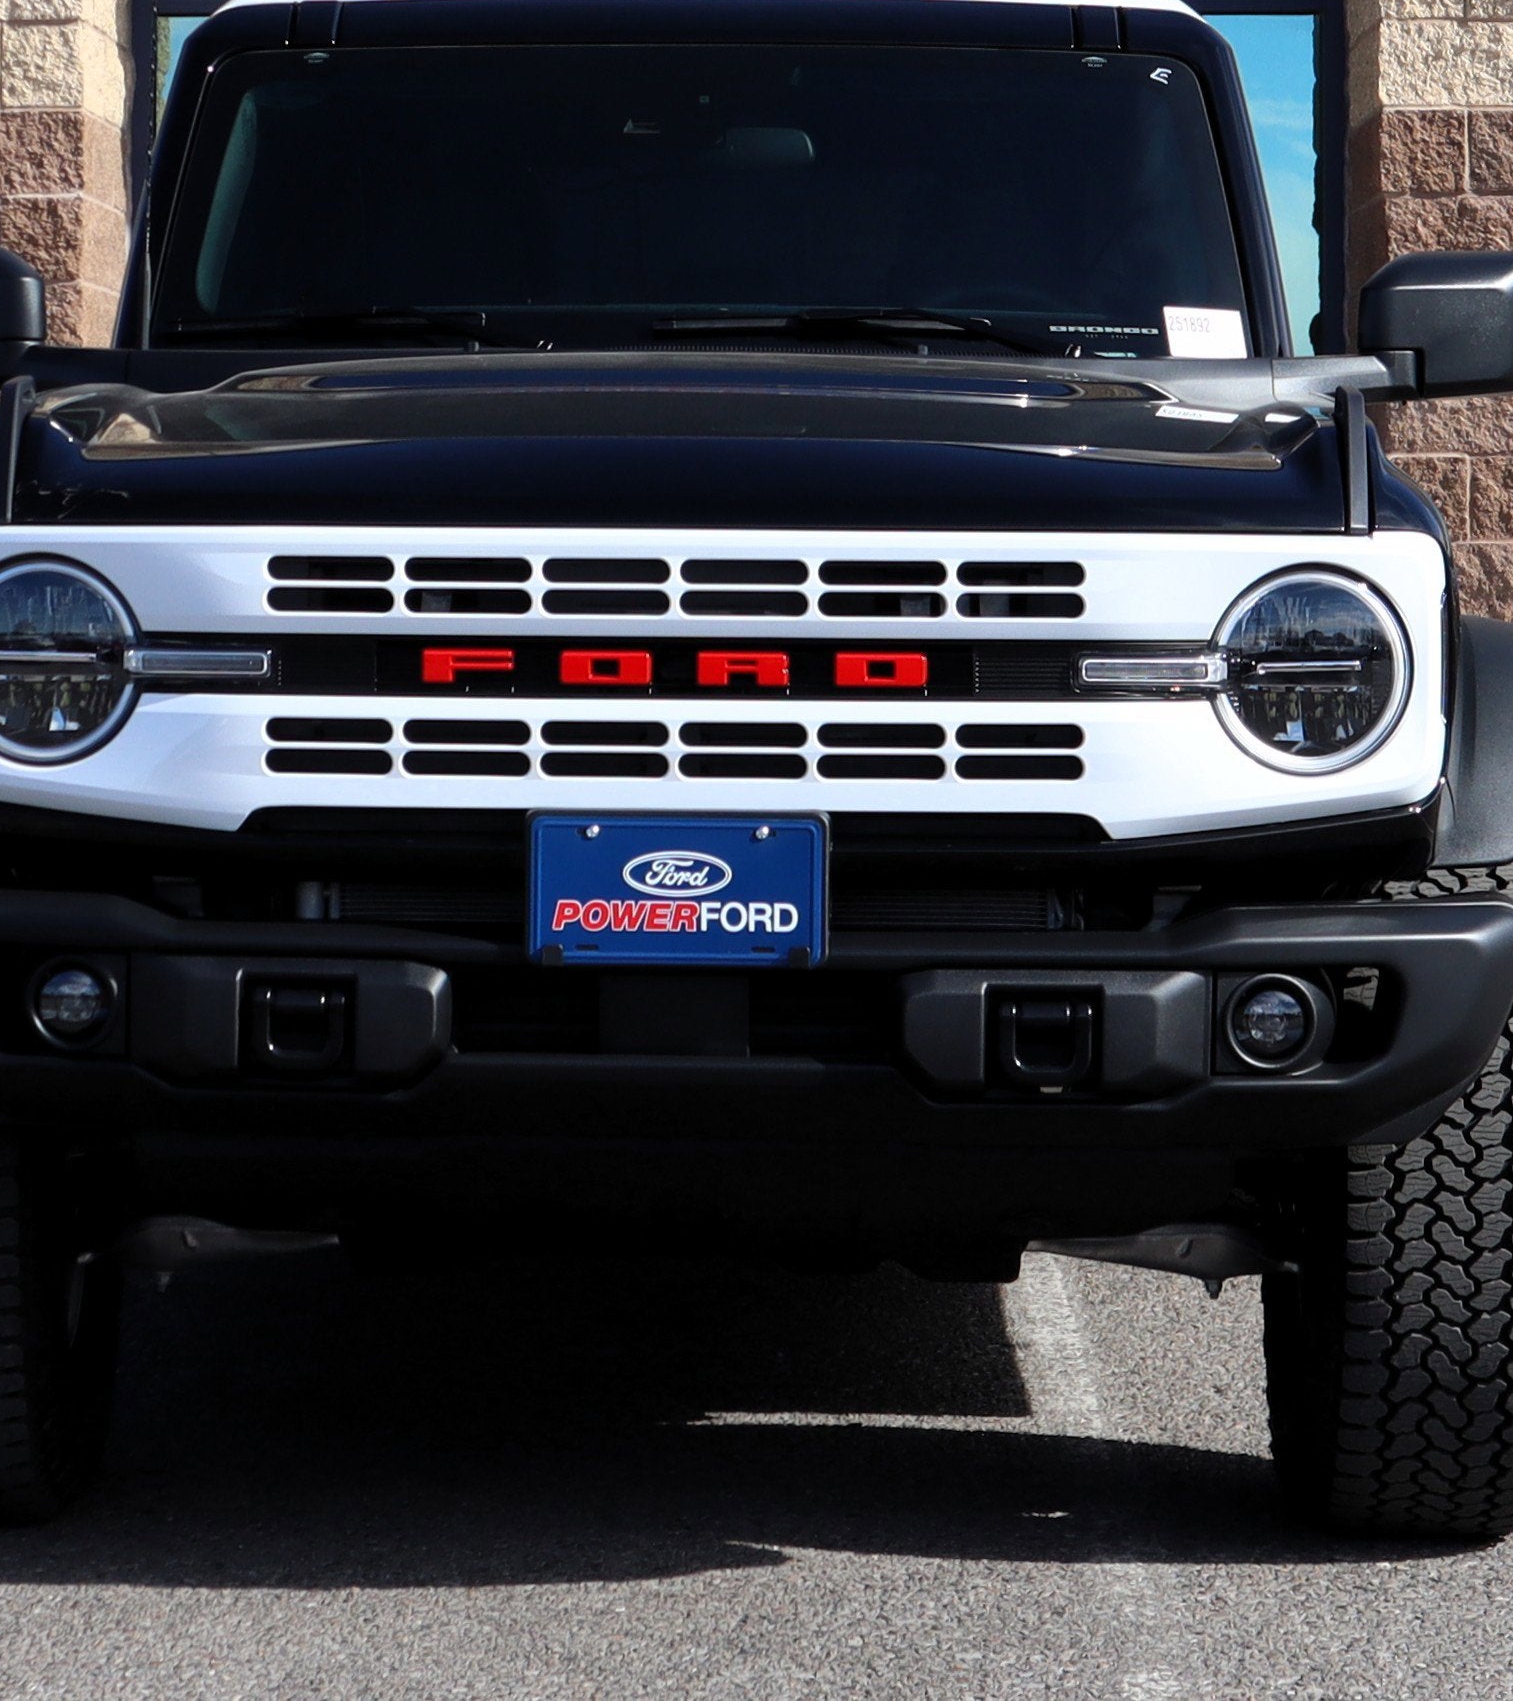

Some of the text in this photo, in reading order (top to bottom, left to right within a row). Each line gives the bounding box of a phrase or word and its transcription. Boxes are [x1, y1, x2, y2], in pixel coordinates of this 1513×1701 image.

[1168, 315, 1211, 333] 251892
[422, 648, 927, 687] FORD
[645, 859, 708, 887] Ford
